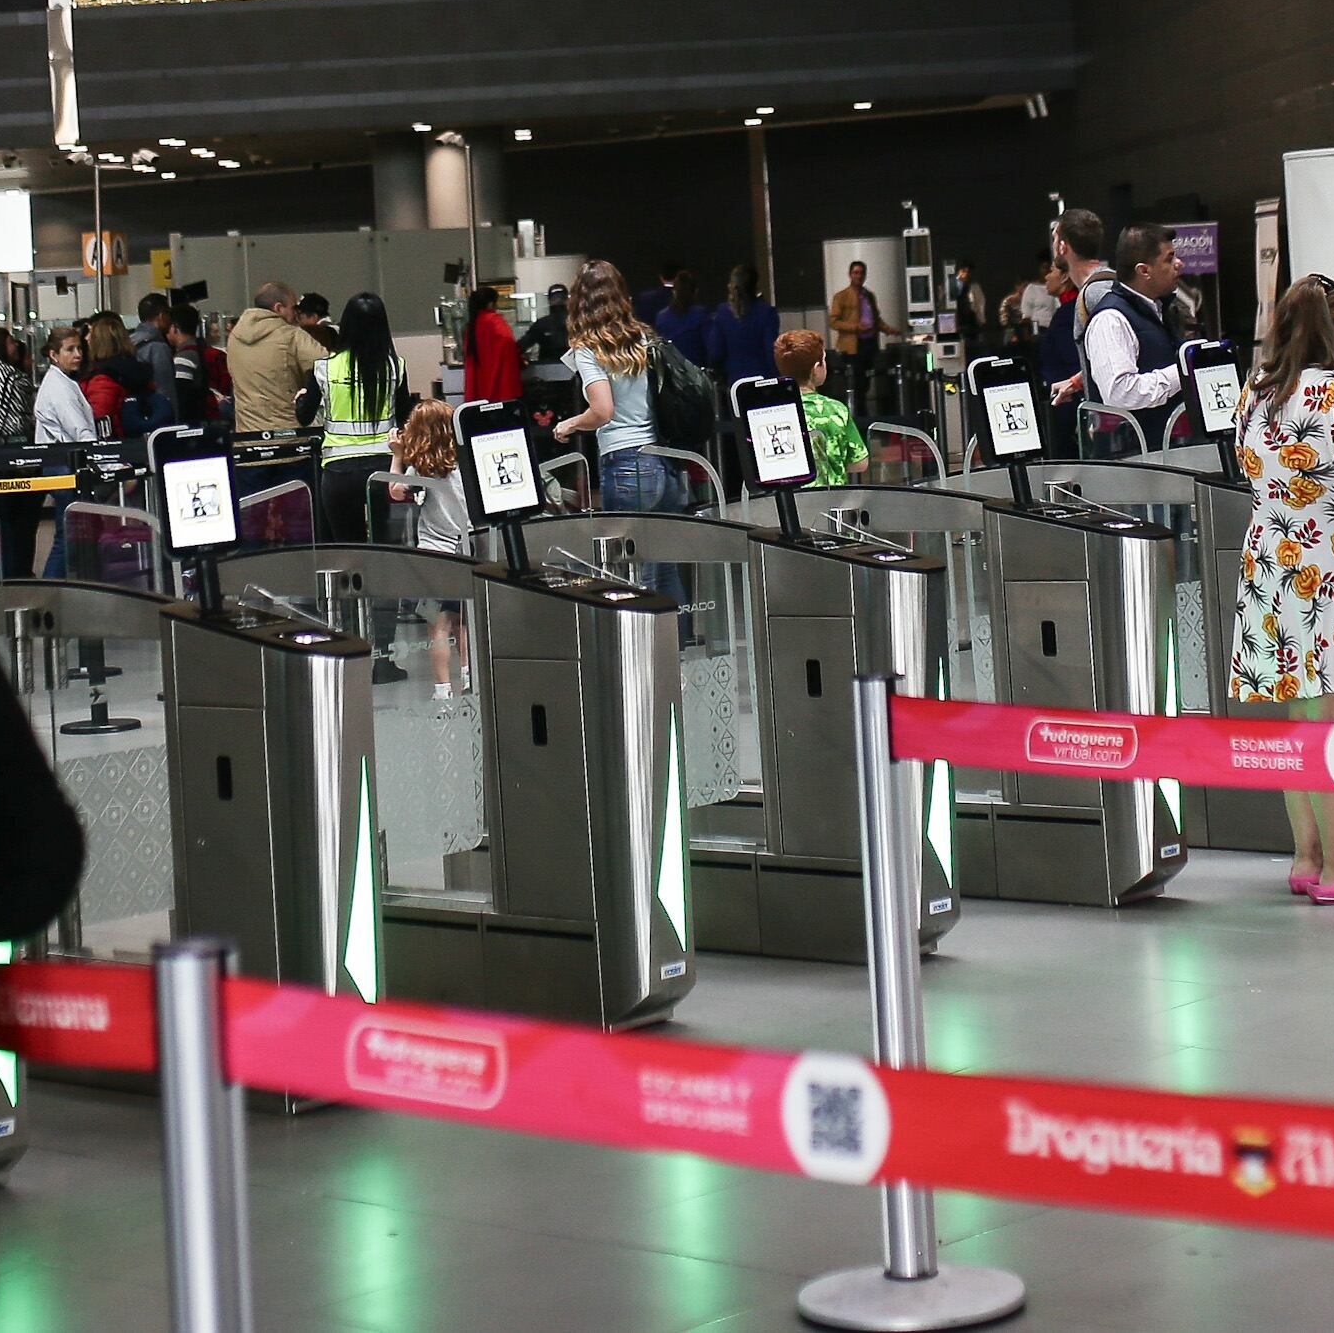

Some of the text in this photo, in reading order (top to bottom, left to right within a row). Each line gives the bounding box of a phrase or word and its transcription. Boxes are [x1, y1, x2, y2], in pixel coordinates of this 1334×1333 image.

[1053, 744, 1122, 763] virtual.com
[1231, 737, 1305, 754] ESCANEA Y
[1233, 754, 1305, 771] DESCUBRE
